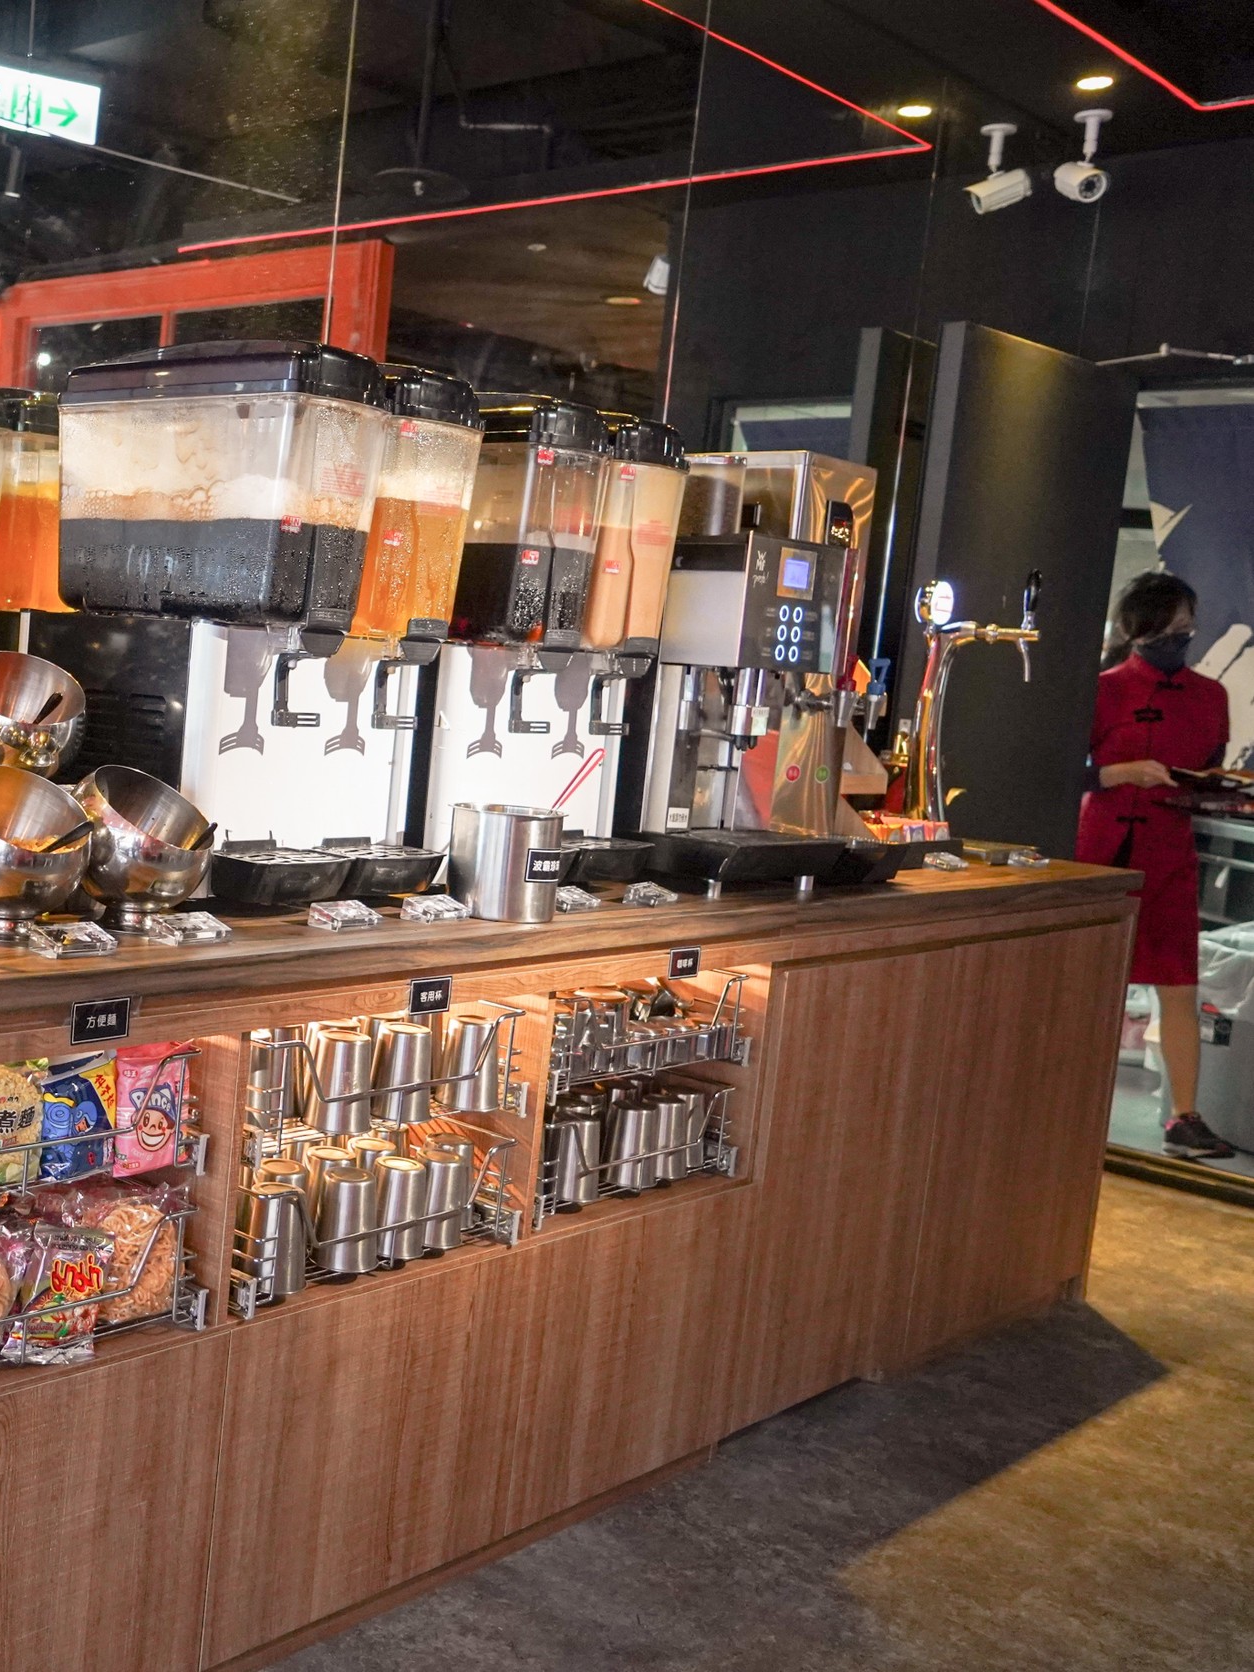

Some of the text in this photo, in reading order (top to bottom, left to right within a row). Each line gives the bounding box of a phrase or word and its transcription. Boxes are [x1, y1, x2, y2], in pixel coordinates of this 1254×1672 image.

[419, 990, 443, 1003] 客用杯
[86, 1013, 117, 1029] 方便麵
